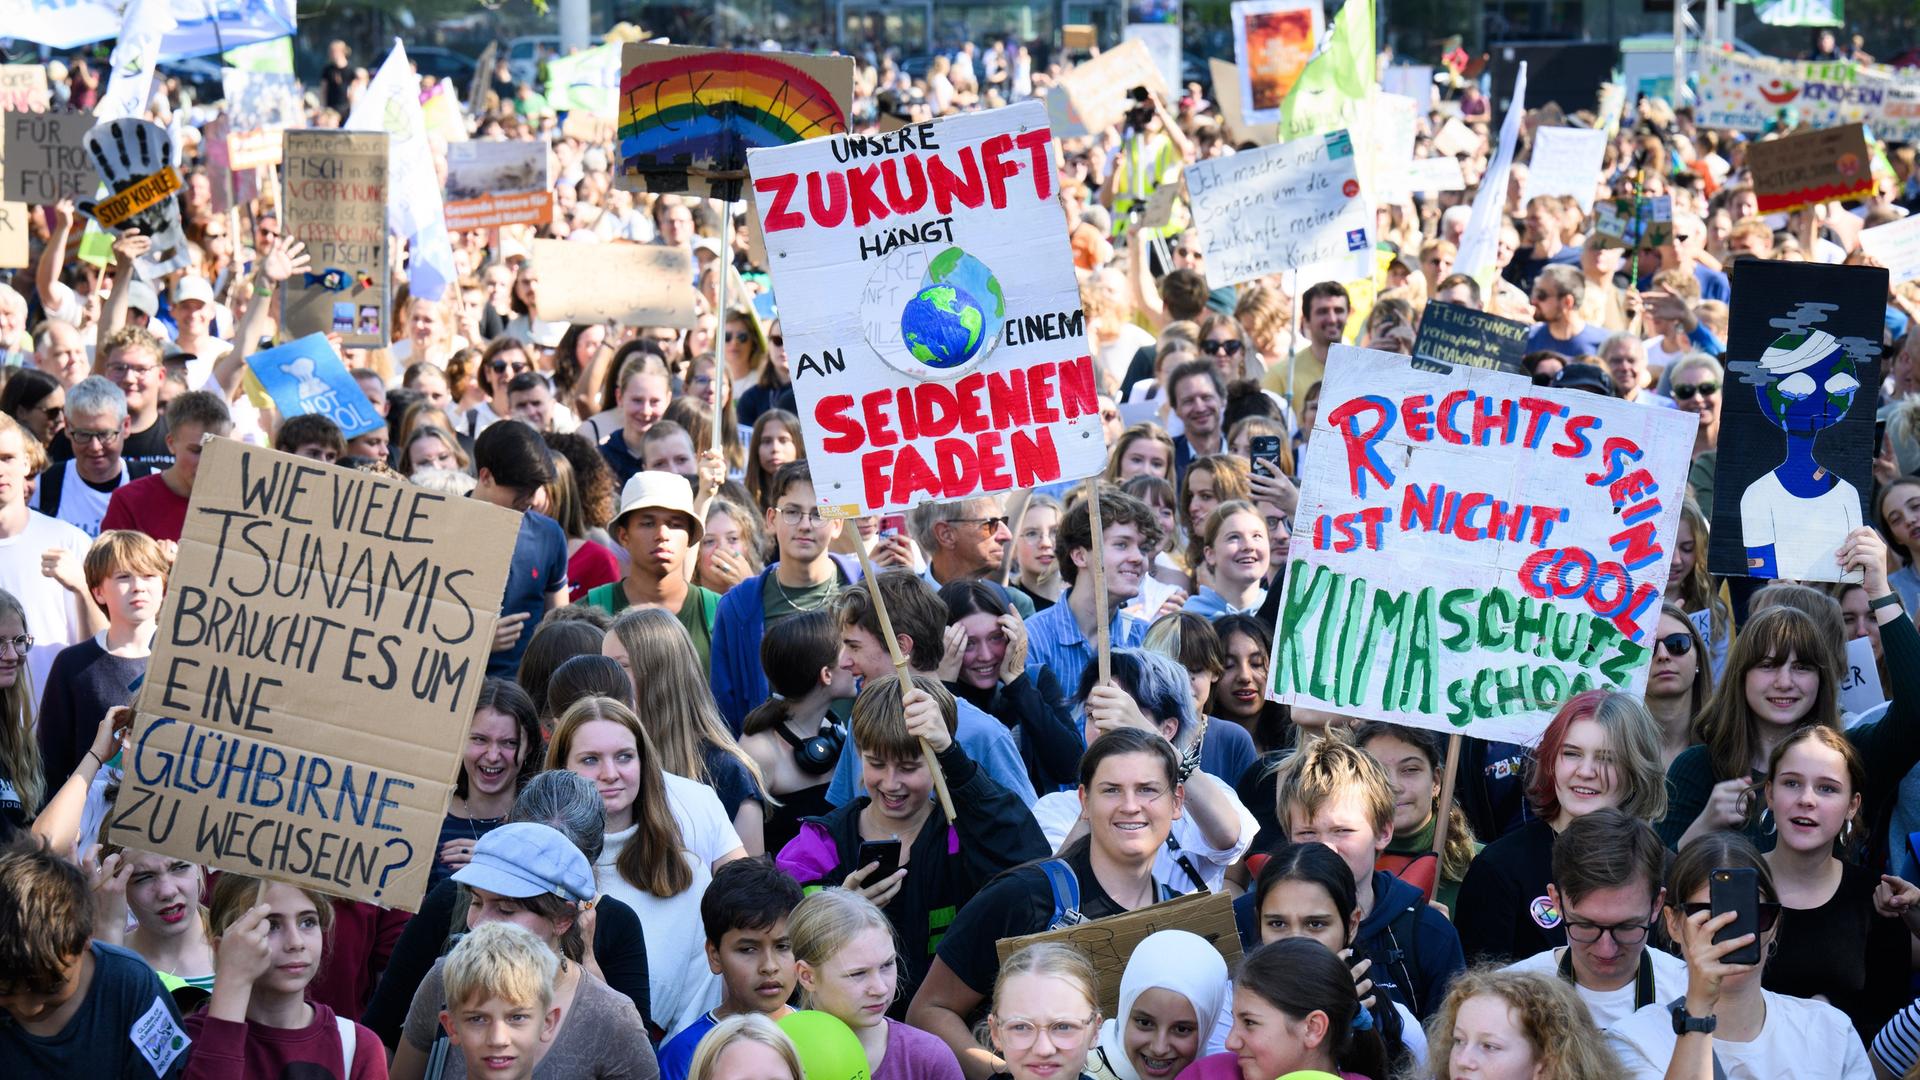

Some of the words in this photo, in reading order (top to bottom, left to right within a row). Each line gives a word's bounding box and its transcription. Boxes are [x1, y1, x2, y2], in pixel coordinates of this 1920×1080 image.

[16, 117, 61, 144] FÜR
[625, 70, 714, 140] FCK
[287, 157, 343, 179] FISCH
[831, 123, 940, 163] UNSERE
[1190, 164, 1223, 197] Ich
[1234, 149, 1287, 182] mache
[98, 195, 131, 224] STOP
[130, 174, 173, 207] KOHLE
[753, 127, 1052, 234] ZUKUNFT
[1199, 192, 1265, 225] Sorgen
[1272, 186, 1297, 201] um
[1306, 173, 1330, 193] die
[859, 217, 954, 262] HÄNGT
[1206, 214, 1280, 255] Zukunft
[1289, 203, 1347, 233] meiner
[796, 347, 846, 381] AN
[1005, 309, 1084, 346] EINEM
[1432, 302, 1527, 342] FEHLSTUNDEN
[300, 390, 342, 416] NOT
[814, 355, 1099, 454] SEIDENEN
[240, 452, 326, 525] WIE
[332, 473, 446, 544] VIELE
[861, 426, 1062, 511] FADEN
[197, 507, 476, 645] TSUNAMIS
[1313, 506, 1393, 553] IST
[1400, 482, 1570, 549] NICHT
[1517, 545, 1660, 642] COOL
[172, 585, 347, 674] BRAUCHT
[341, 627, 402, 691] ES
[412, 647, 470, 713] UM
[161, 657, 283, 734] EINE
[133, 717, 415, 833] GLÜHBIRNE
[110, 786, 178, 844] ZU
[195, 805, 414, 898] WECHSELN?
